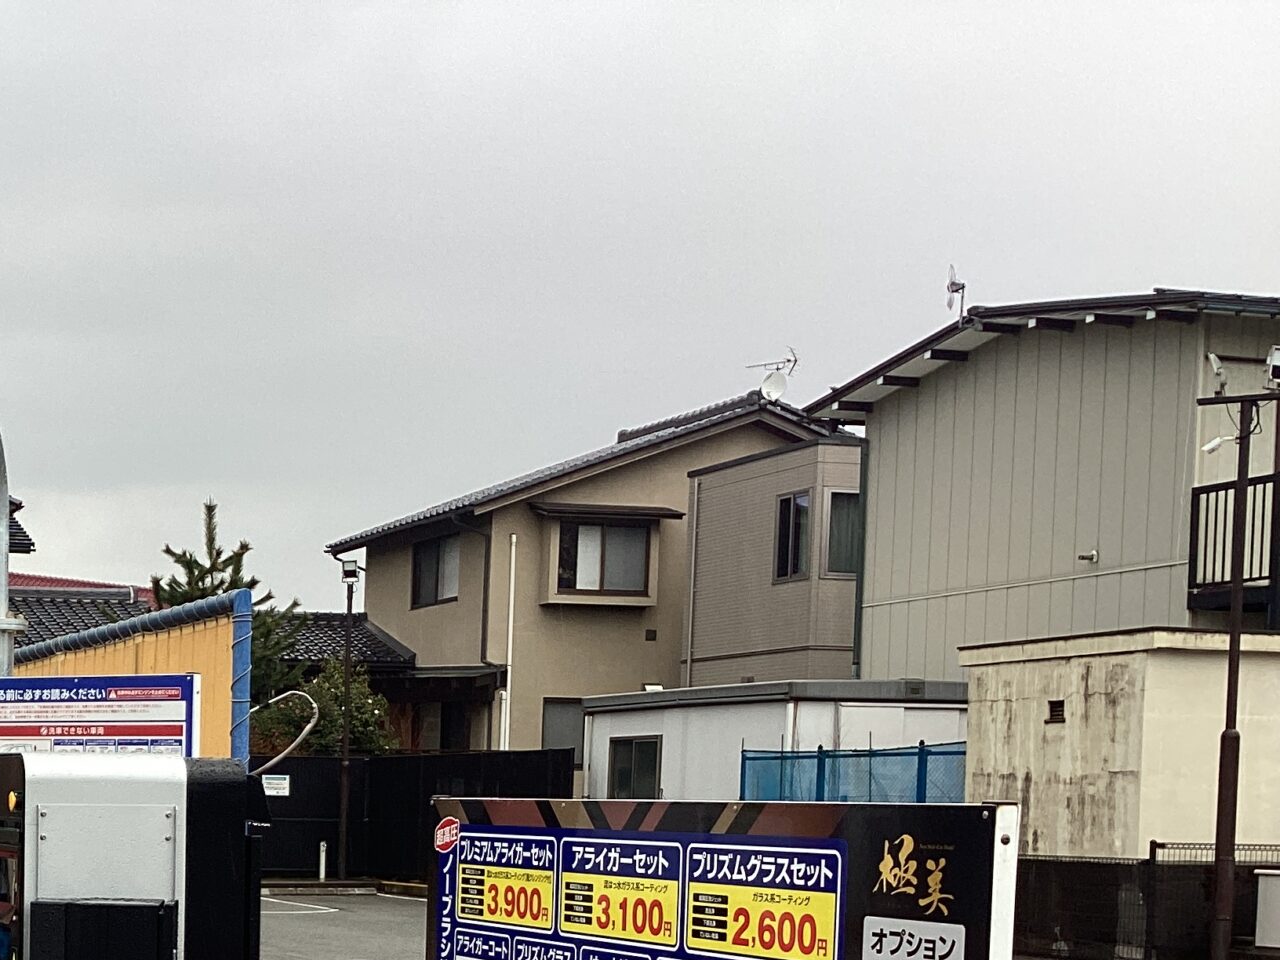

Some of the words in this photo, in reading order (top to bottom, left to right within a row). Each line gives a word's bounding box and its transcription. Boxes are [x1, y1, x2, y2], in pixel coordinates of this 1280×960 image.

[48, 726, 104, 736] 洗車できない車両
[461, 839, 553, 867] プレミアムアライガーセット
[572, 846, 669, 875] アライガーセット
[692, 851, 833, 888] プリズムグラスセット
[487, 883, 549, 922] 3,900円
[752, 892, 811, 907] ガラス系コーティング
[596, 894, 672, 937] 3,100円
[457, 935, 508, 959] アライガーコート
[731, 907, 828, 957] 2,600円
[871, 928, 956, 960] オプション
